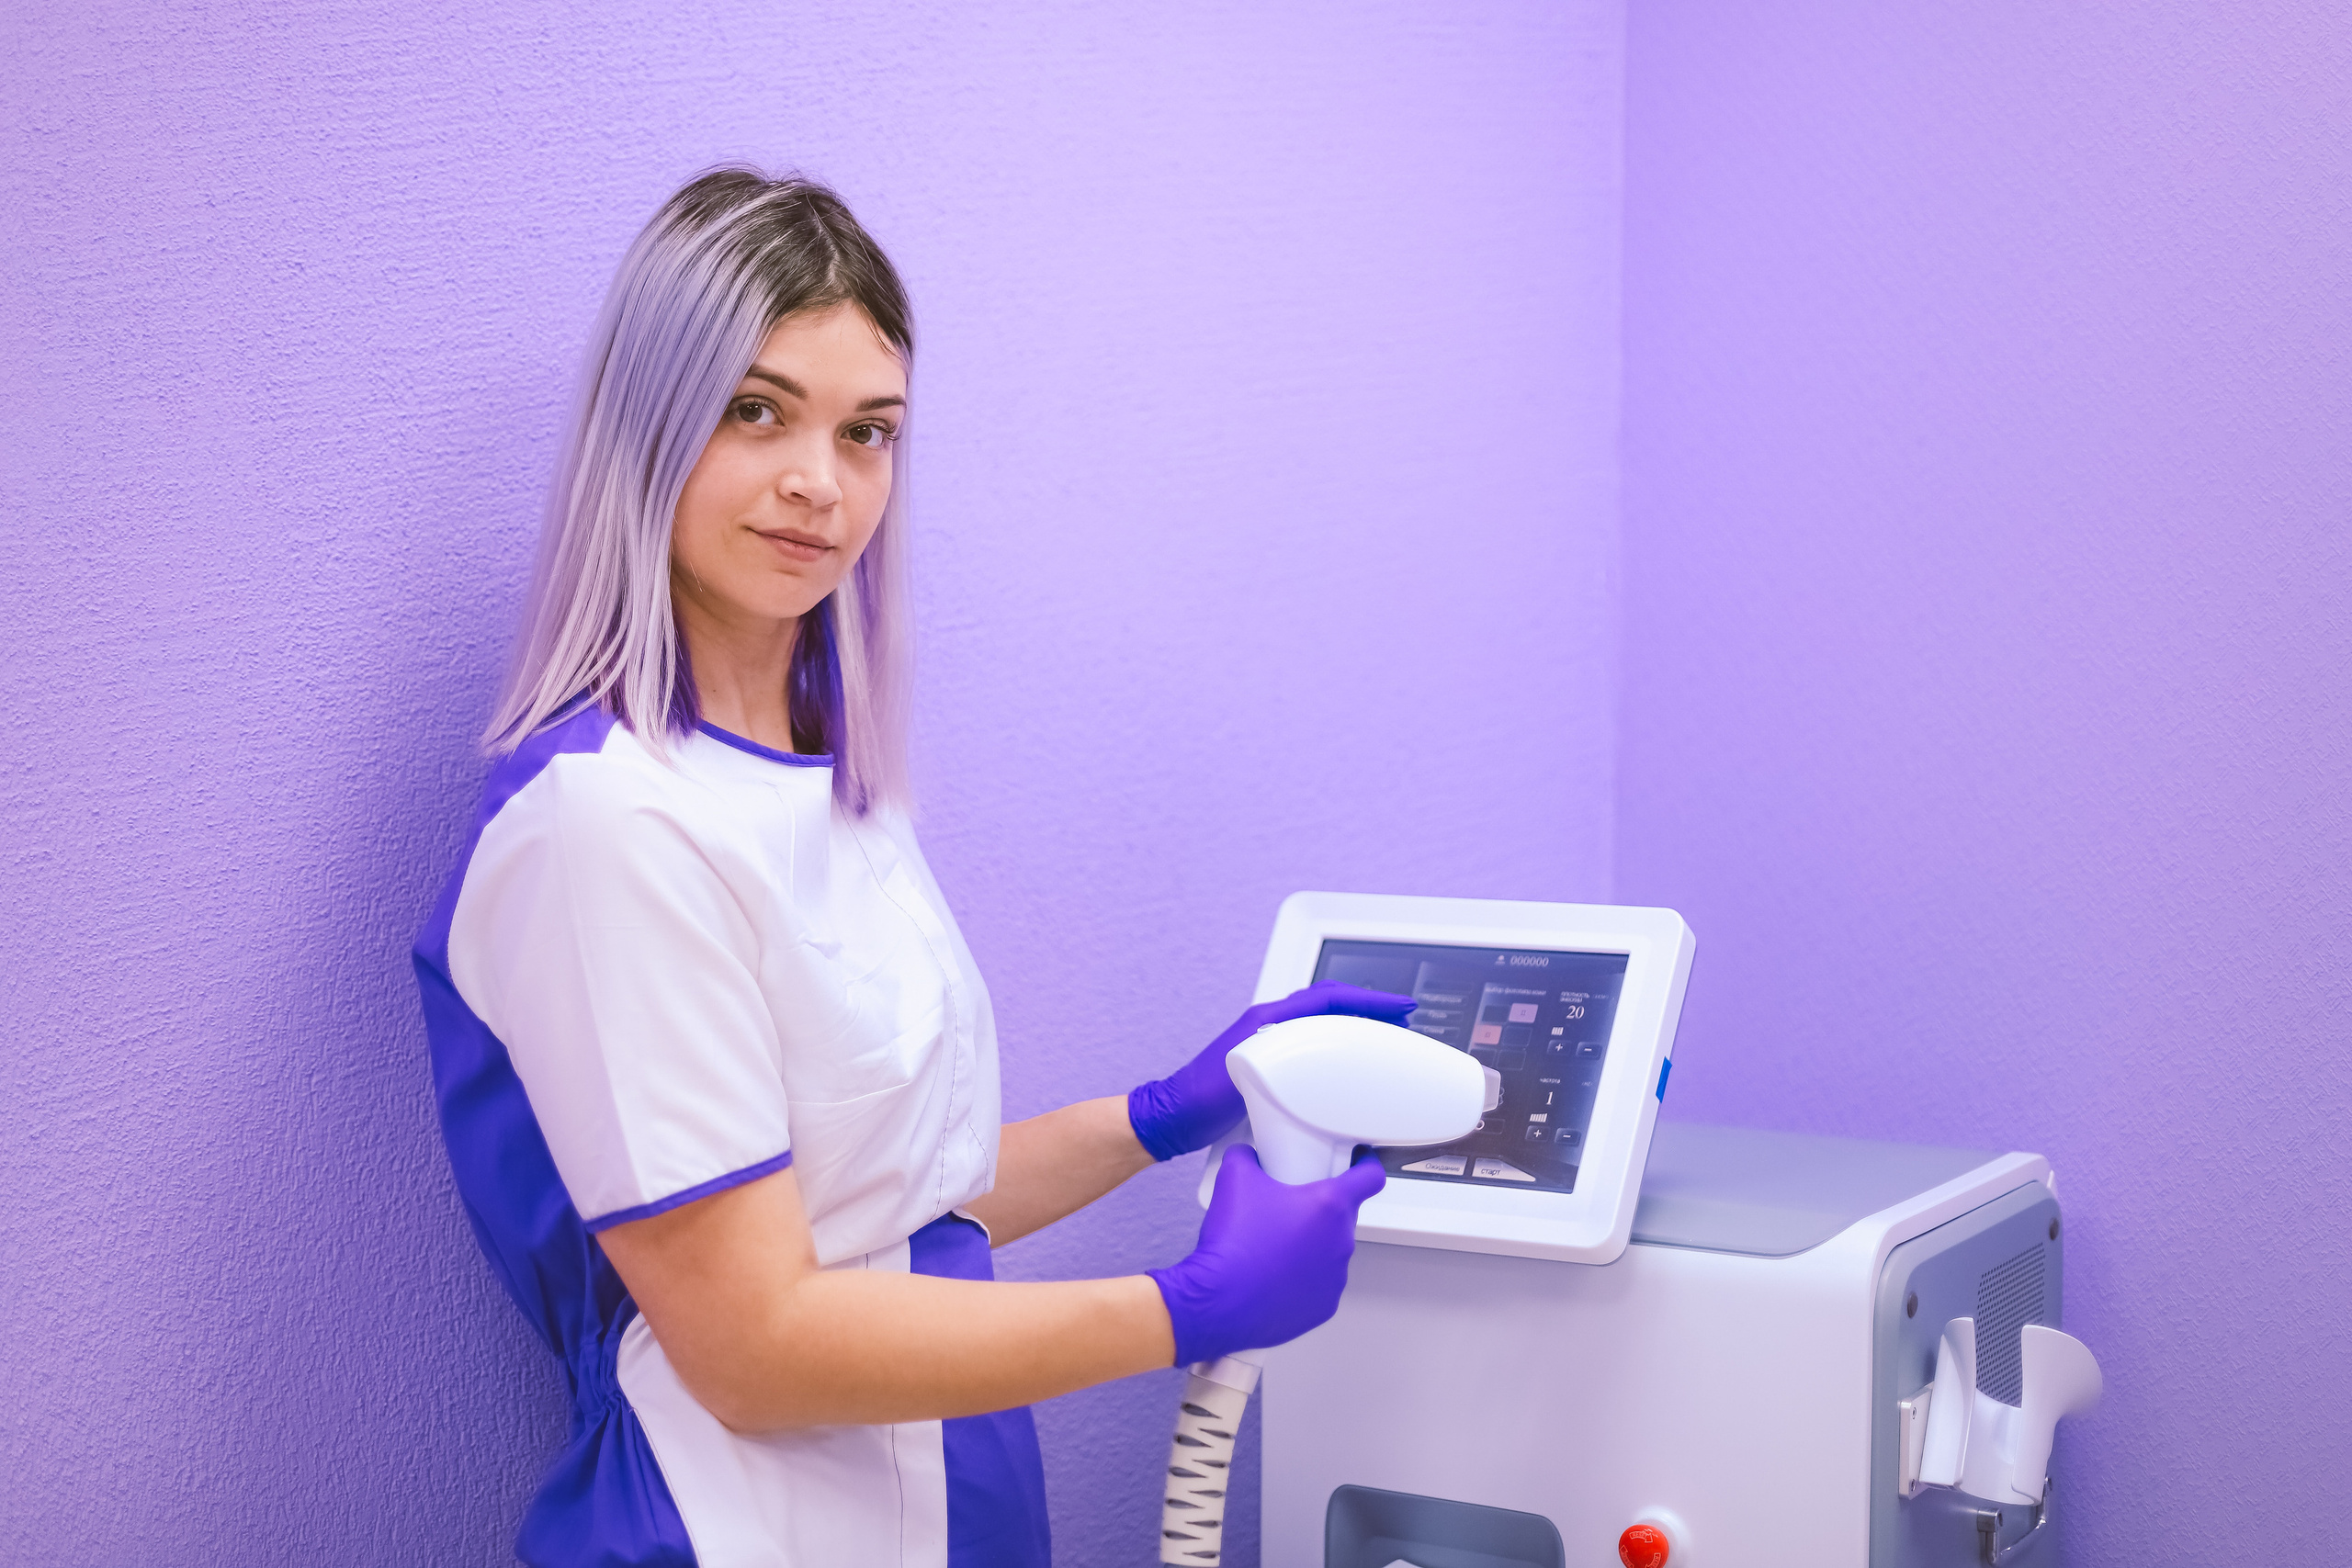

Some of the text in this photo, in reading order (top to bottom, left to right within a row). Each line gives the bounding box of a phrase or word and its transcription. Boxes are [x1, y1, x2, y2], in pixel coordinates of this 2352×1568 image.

[1510, 955, 1549, 966] 000000
[1566, 1005, 1585, 1020] 20
[1546, 1091, 1554, 1105] 1
[1425, 1162, 1461, 1172] Ожидание
[1481, 1168, 1501, 1176] старт
